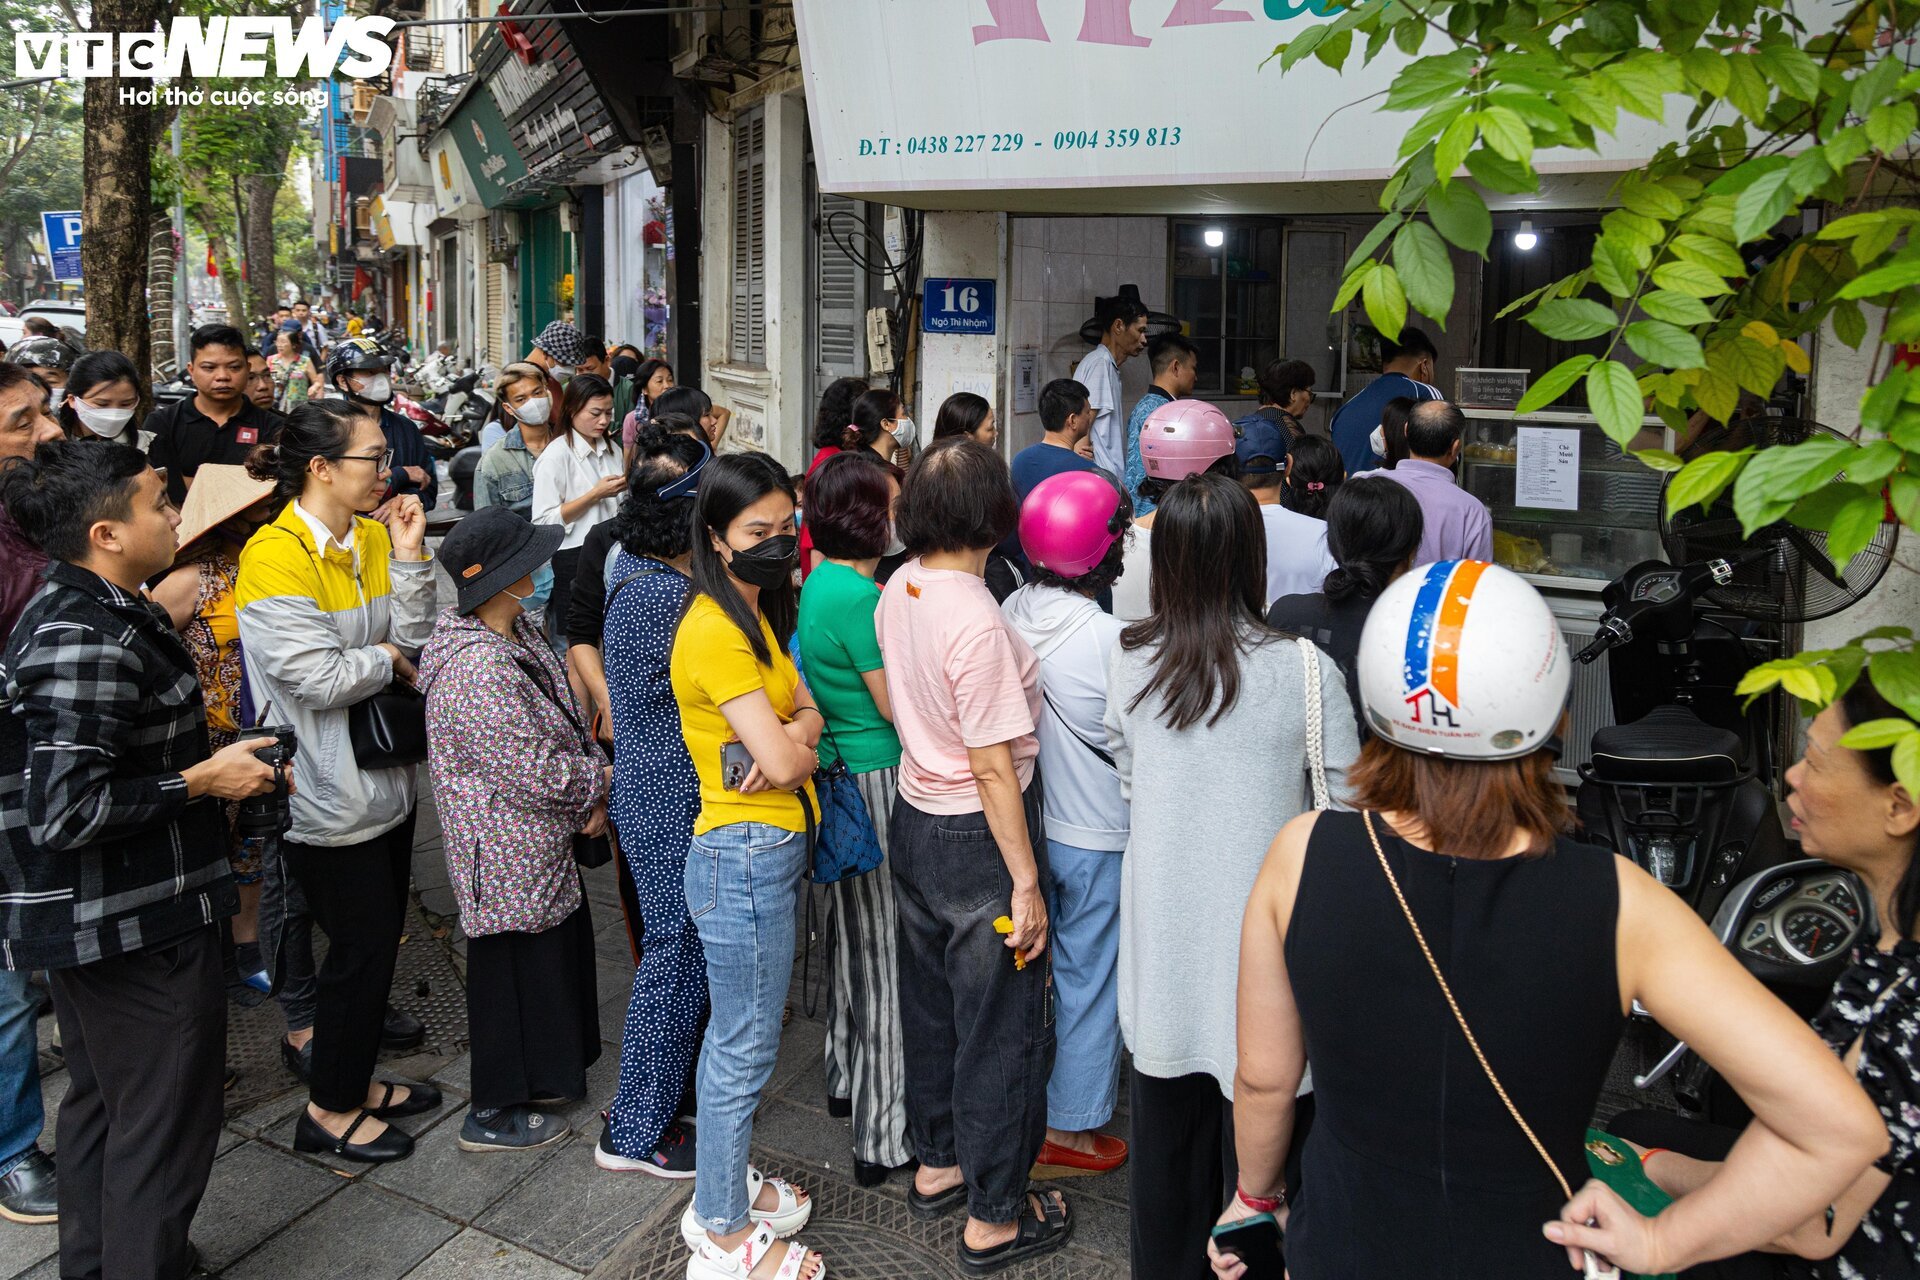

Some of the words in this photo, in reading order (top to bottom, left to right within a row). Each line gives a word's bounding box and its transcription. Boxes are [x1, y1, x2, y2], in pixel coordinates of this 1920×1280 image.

[859, 138, 891, 156] Đ.T
[907, 136, 948, 154] 0438
[954, 135, 986, 153] 227
[991, 133, 1023, 152] 229
[1054, 130, 1098, 150] 0904
[1105, 128, 1140, 148] 359
[1146, 126, 1182, 147] 813
[940, 286, 980, 313] 16
[931, 317, 949, 328] Ngô
[962, 318, 988, 329] Nhậm
